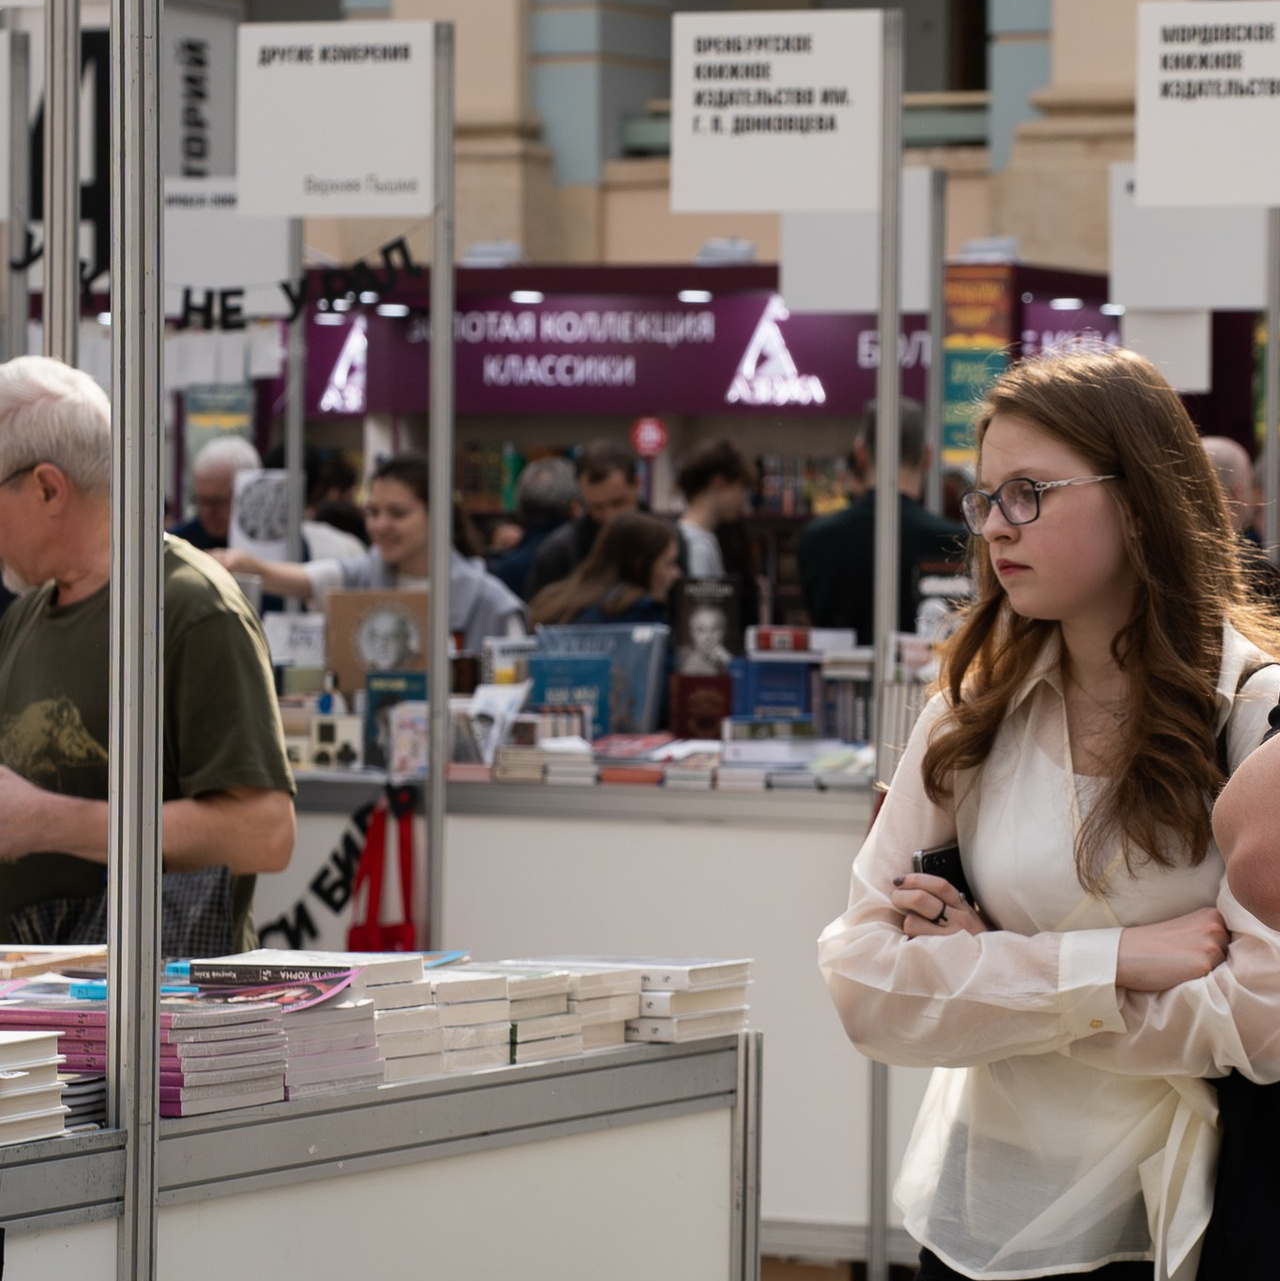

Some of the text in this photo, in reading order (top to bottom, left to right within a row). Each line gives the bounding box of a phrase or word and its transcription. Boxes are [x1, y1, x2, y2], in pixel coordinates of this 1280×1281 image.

[1161, 23, 1276, 46] МОРДОВСКОЕ
[694, 62, 771, 81] КНИЖНОЕ
[1161, 52, 1243, 71] КНИЖНОЕ
[694, 89, 814, 109] ИЗДАТЕЛЬСТВО
[180, 285, 246, 332] НЕ
